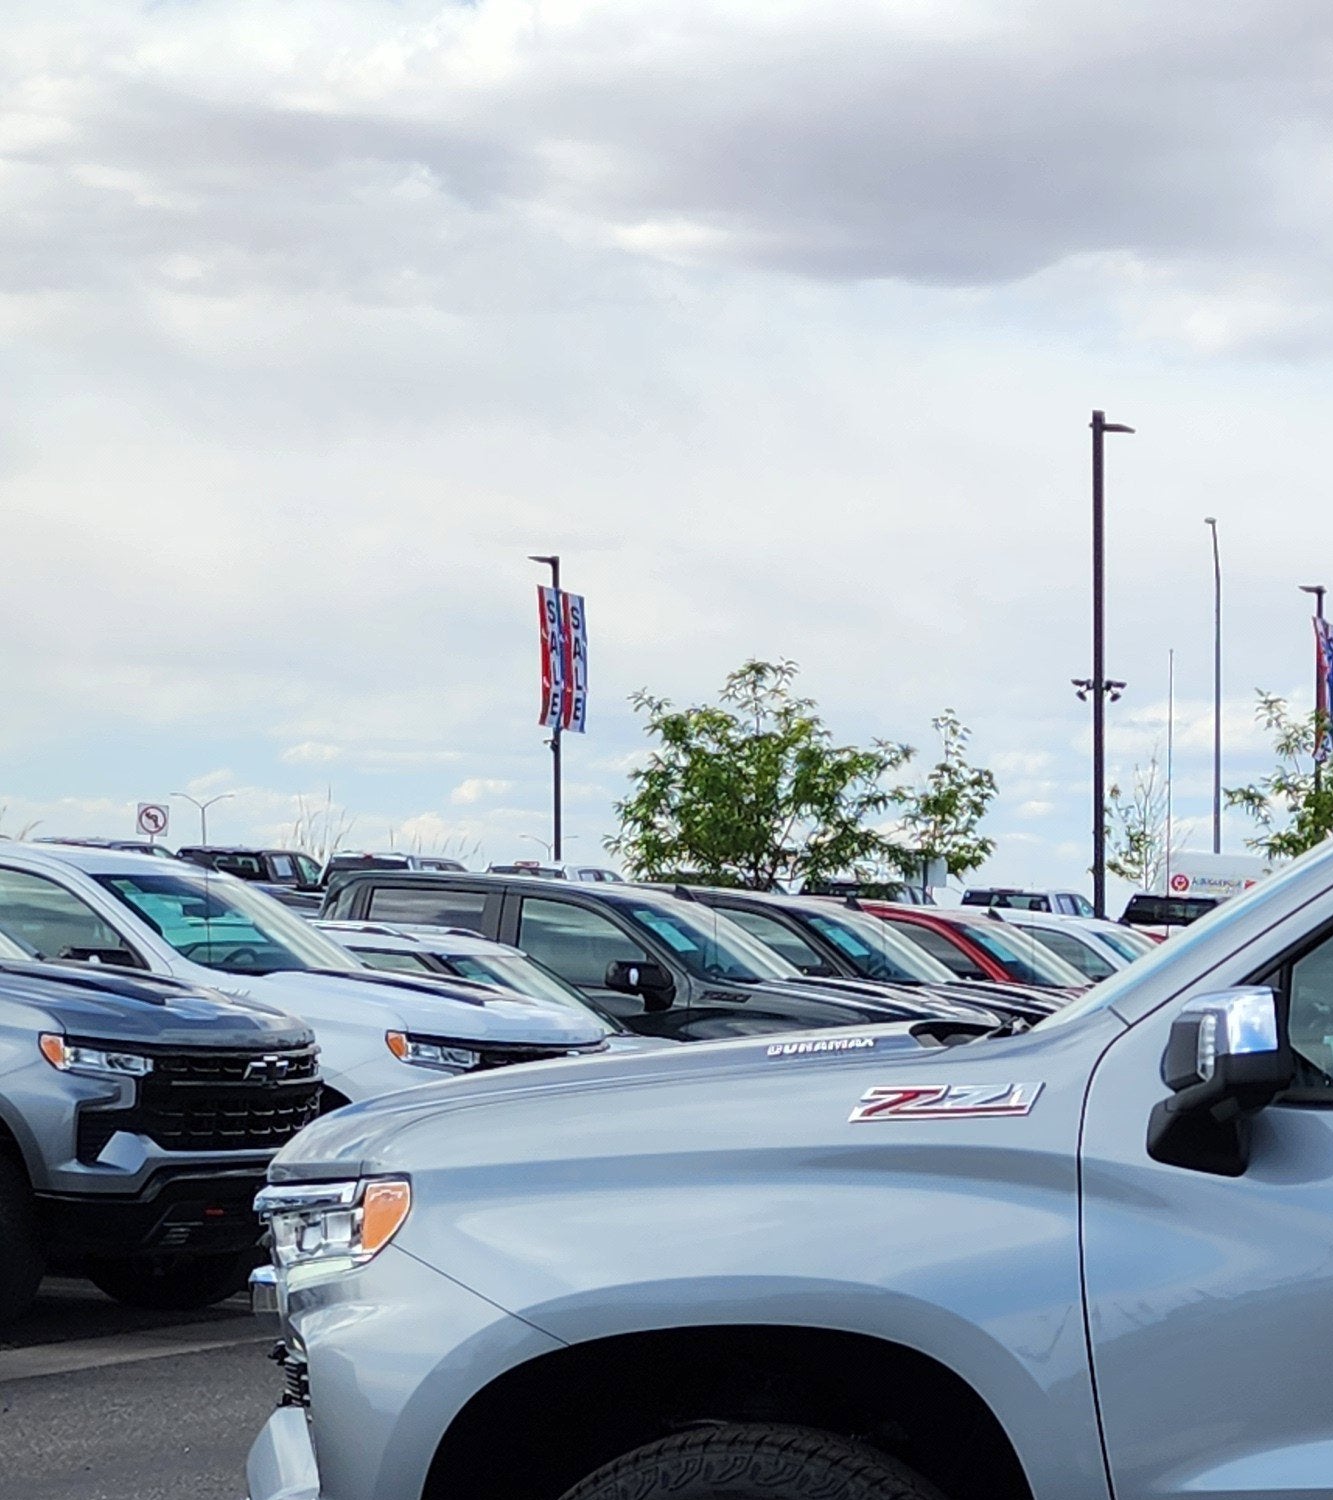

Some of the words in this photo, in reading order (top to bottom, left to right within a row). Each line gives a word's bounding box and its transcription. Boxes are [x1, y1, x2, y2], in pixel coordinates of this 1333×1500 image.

[546, 600, 559, 716] SALE
[570, 606, 583, 721] SALE
[767, 1037, 875, 1056] DURAMAX
[848, 1081, 1047, 1123] Z71
